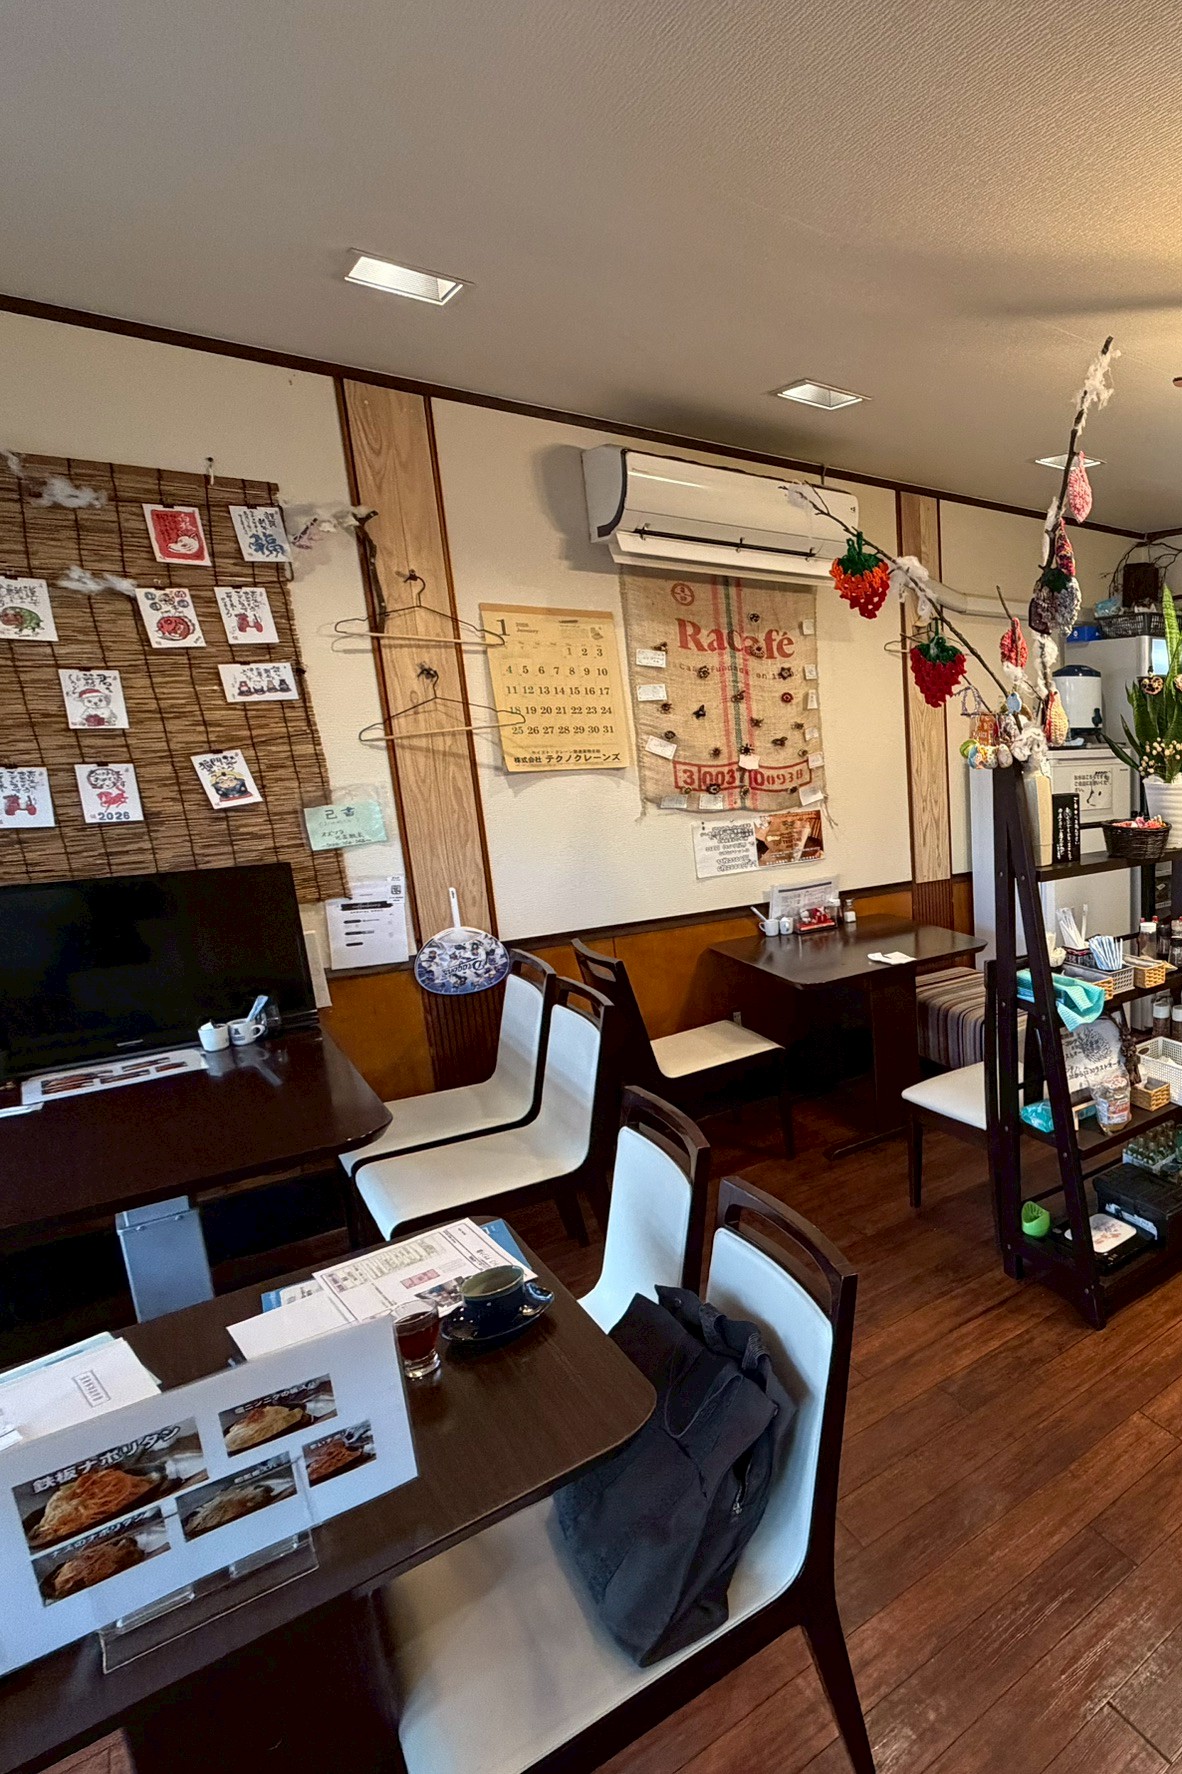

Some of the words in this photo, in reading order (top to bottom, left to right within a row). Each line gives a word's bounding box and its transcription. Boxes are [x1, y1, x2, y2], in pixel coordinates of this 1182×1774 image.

[496, 619, 510, 636] 1
[676, 617, 796, 660] Racafé
[581, 648, 588, 656] 2
[522, 666, 529, 674] 5
[538, 666, 545, 674] 6
[569, 667, 576, 675] 8
[597, 668, 608, 676] 10
[506, 686, 518, 694] 11
[522, 686, 534, 694] 12
[538, 686, 550, 694] 13
[554, 687, 565, 695] 14
[569, 687, 580, 695] 15
[584, 687, 596, 695] 16
[525, 706, 537, 714] 19
[540, 706, 552, 714] 20
[556, 706, 567, 714] 21
[512, 726, 524, 734] 25
[528, 726, 540, 734] 26
[543, 726, 554, 734] 27
[558, 726, 570, 734] 28
[573, 726, 585, 734] 29
[588, 726, 600, 734] 30
[603, 726, 614, 734] 31
[546, 753, 620, 763] テクノクレーンズ
[682, 768, 697, 787] 3
[97, 811, 131, 821] 2026
[441, 958, 486, 976] Dragons
[31, 1425, 182, 1495] 鉄板ナポリタン
